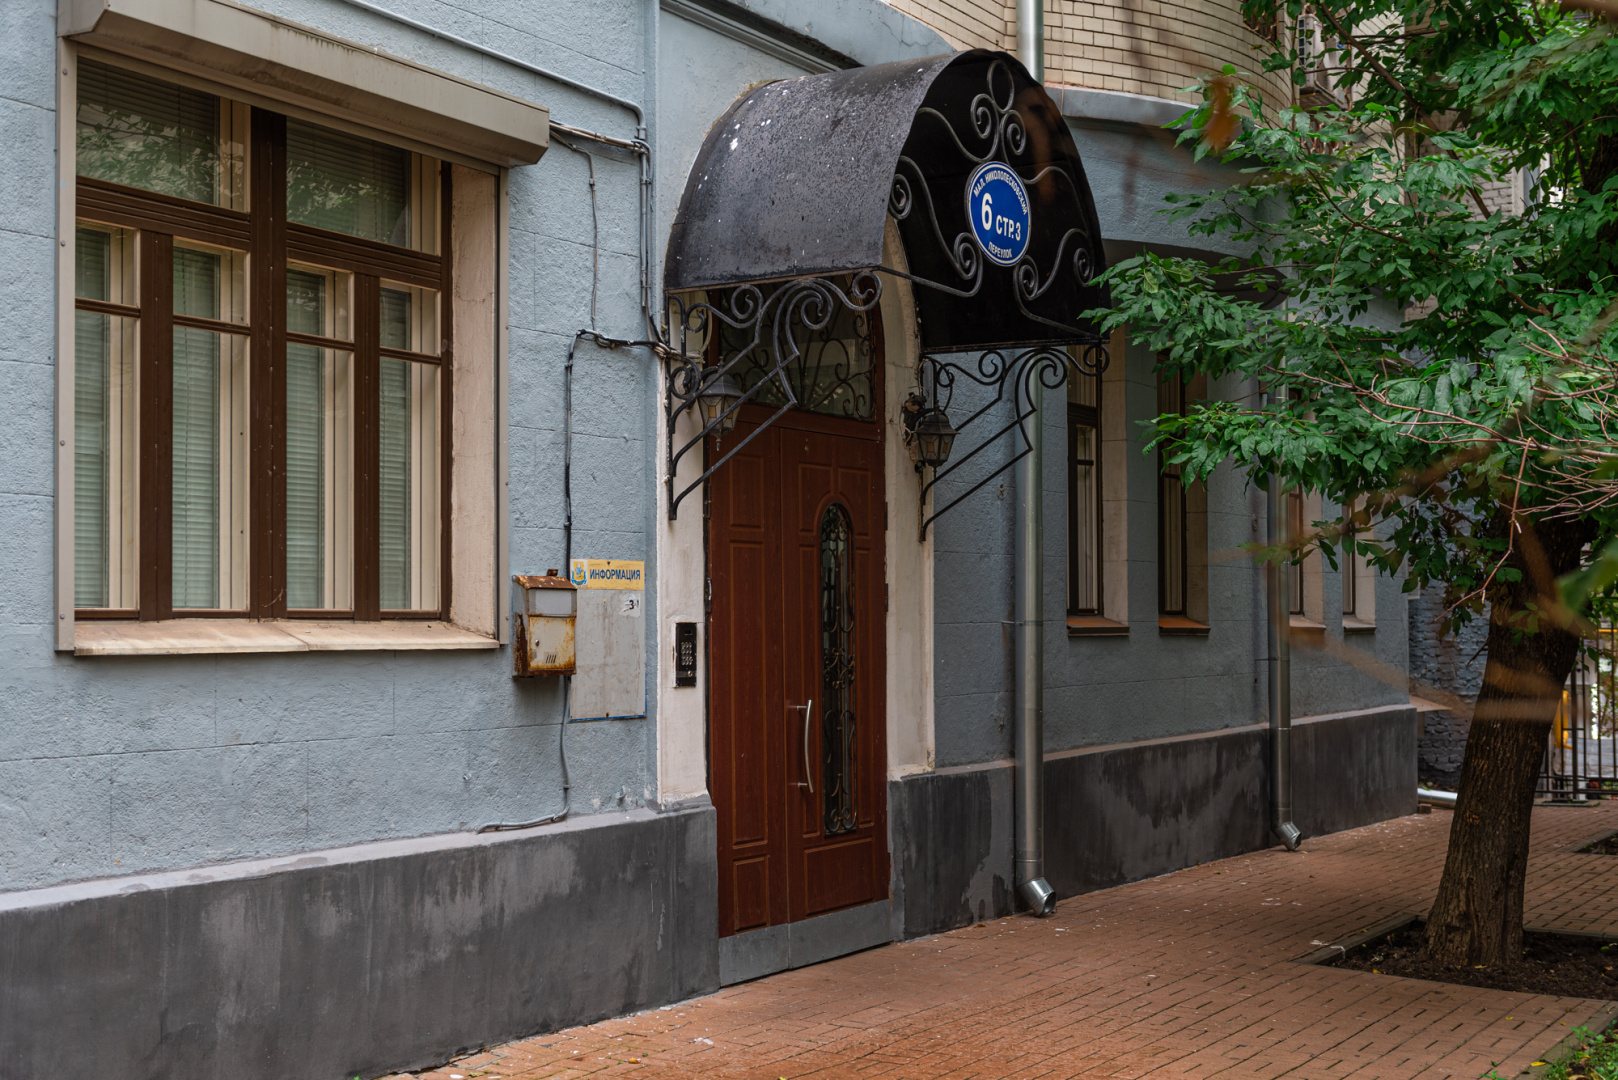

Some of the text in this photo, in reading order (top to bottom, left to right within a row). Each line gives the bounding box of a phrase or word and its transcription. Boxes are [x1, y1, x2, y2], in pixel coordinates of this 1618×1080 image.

[981, 192, 993, 231] 6
[988, 241, 1013, 259] ПЕРЕУЛОК
[589, 568, 641, 582] ИНФОРМАЦИЯ
